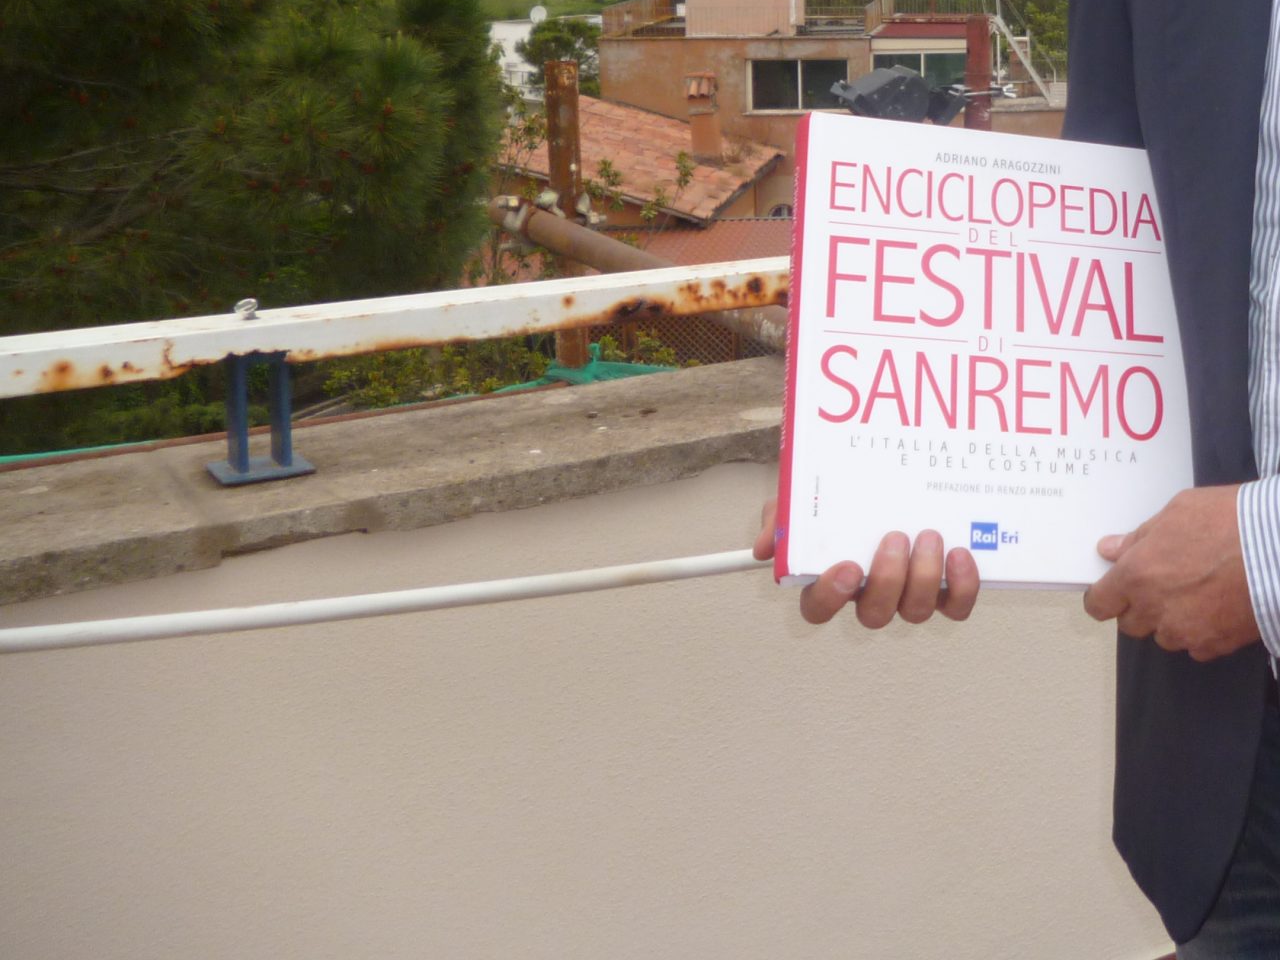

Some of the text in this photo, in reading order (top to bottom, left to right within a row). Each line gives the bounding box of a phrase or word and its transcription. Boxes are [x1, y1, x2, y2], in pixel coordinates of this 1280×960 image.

[935, 152, 1061, 175] ADRIANO ARAGOZZINI
[828, 160, 1162, 242] ENCICLOPEDIA
[967, 226, 1019, 248] DEL
[825, 234, 1165, 344] FESTIVAL
[977, 333, 1004, 353] DI
[817, 343, 1165, 443] SANREMO
[850, 435, 1138, 464] L'ITALIA DELLA MUSICA
[900, 453, 1090, 476] E DEL COSTUME
[926, 481, 981, 495] PREFAZIONE
[972, 529, 1019, 544] Rai Eri
